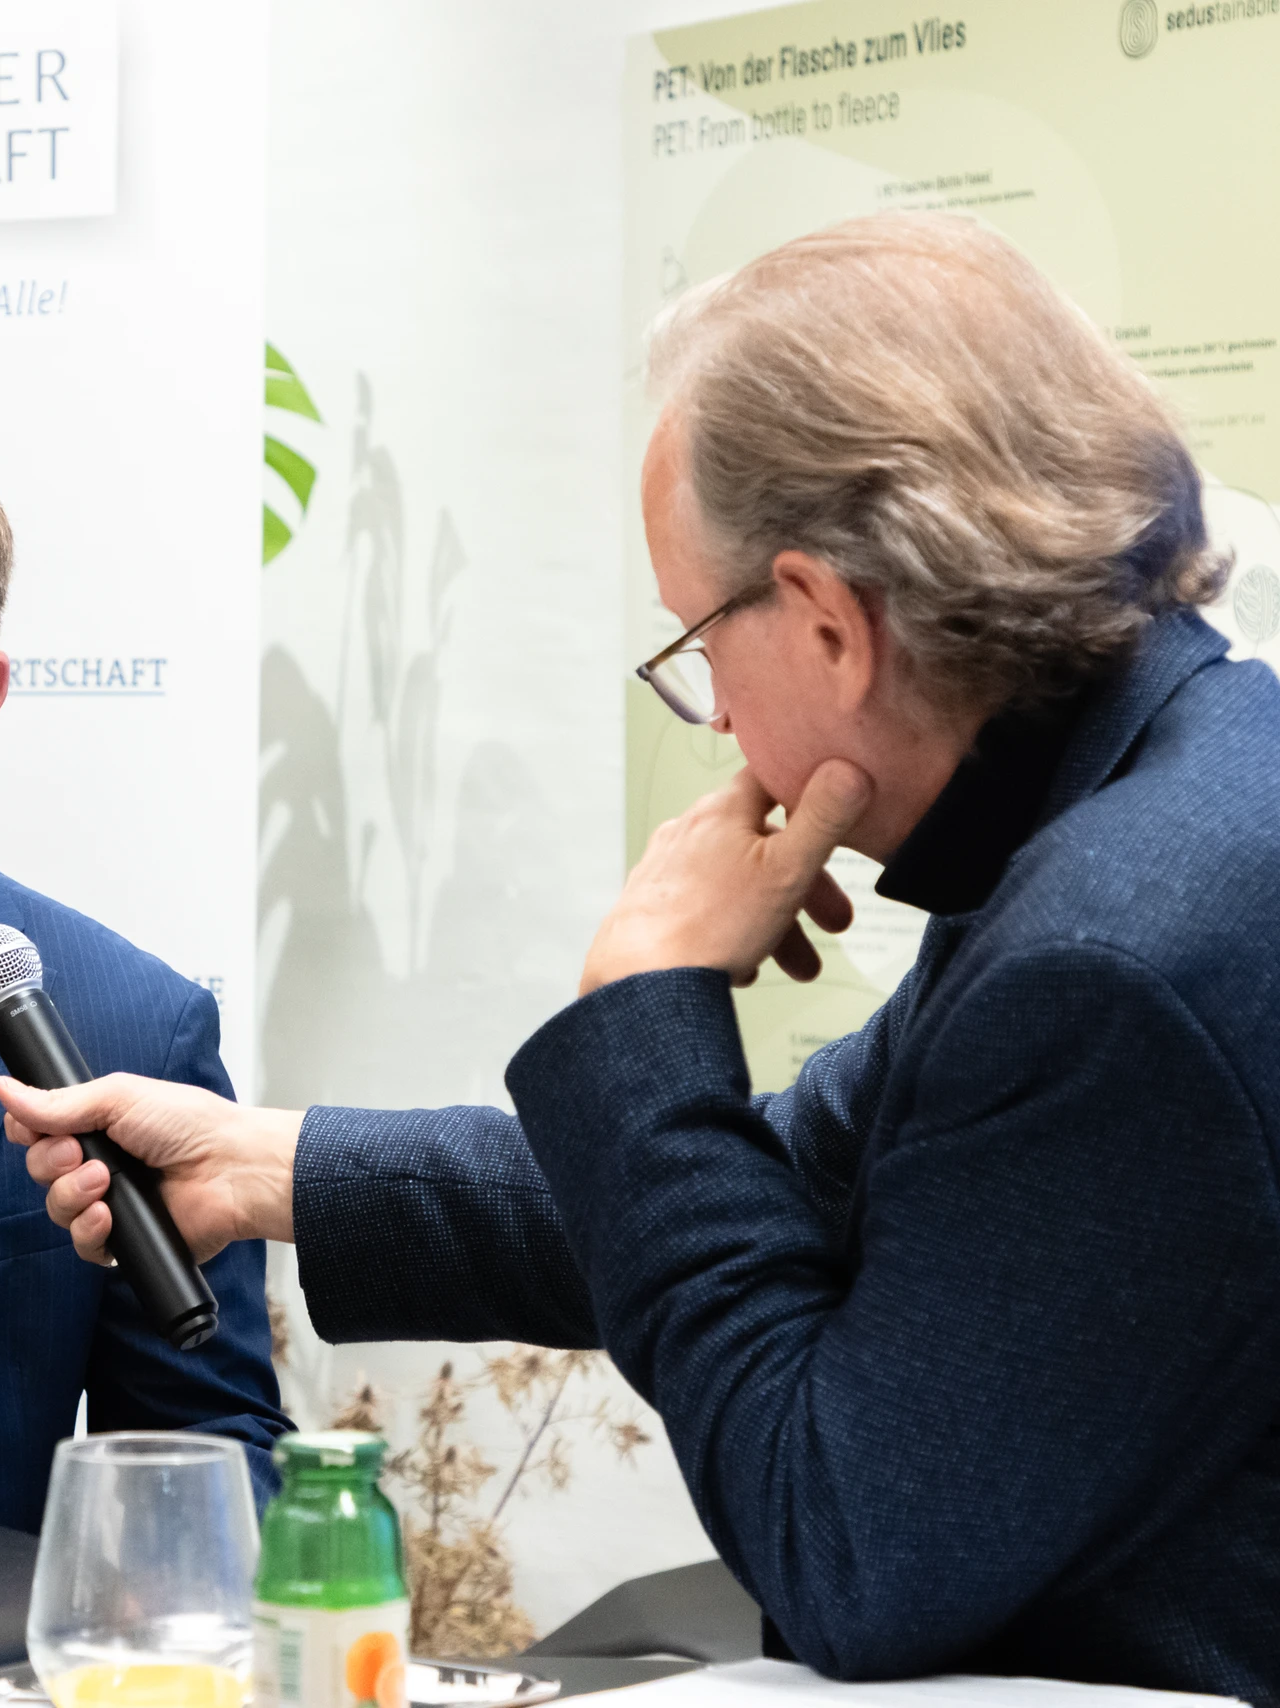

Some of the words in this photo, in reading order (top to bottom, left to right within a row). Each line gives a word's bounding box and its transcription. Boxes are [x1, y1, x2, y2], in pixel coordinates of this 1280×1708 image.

[700, 61, 737, 92] Von
[742, 52, 773, 86] der
[779, 36, 858, 79] Flasche
[864, 31, 907, 65] zum
[914, 17, 967, 54] Vlies
[697, 115, 746, 146] From
[752, 102, 807, 141] bottle
[812, 98, 832, 132] to
[839, 91, 900, 126] fleece
[9, 657, 167, 688] RTSCHAFT
[9, 1004, 29, 1018] SM58
